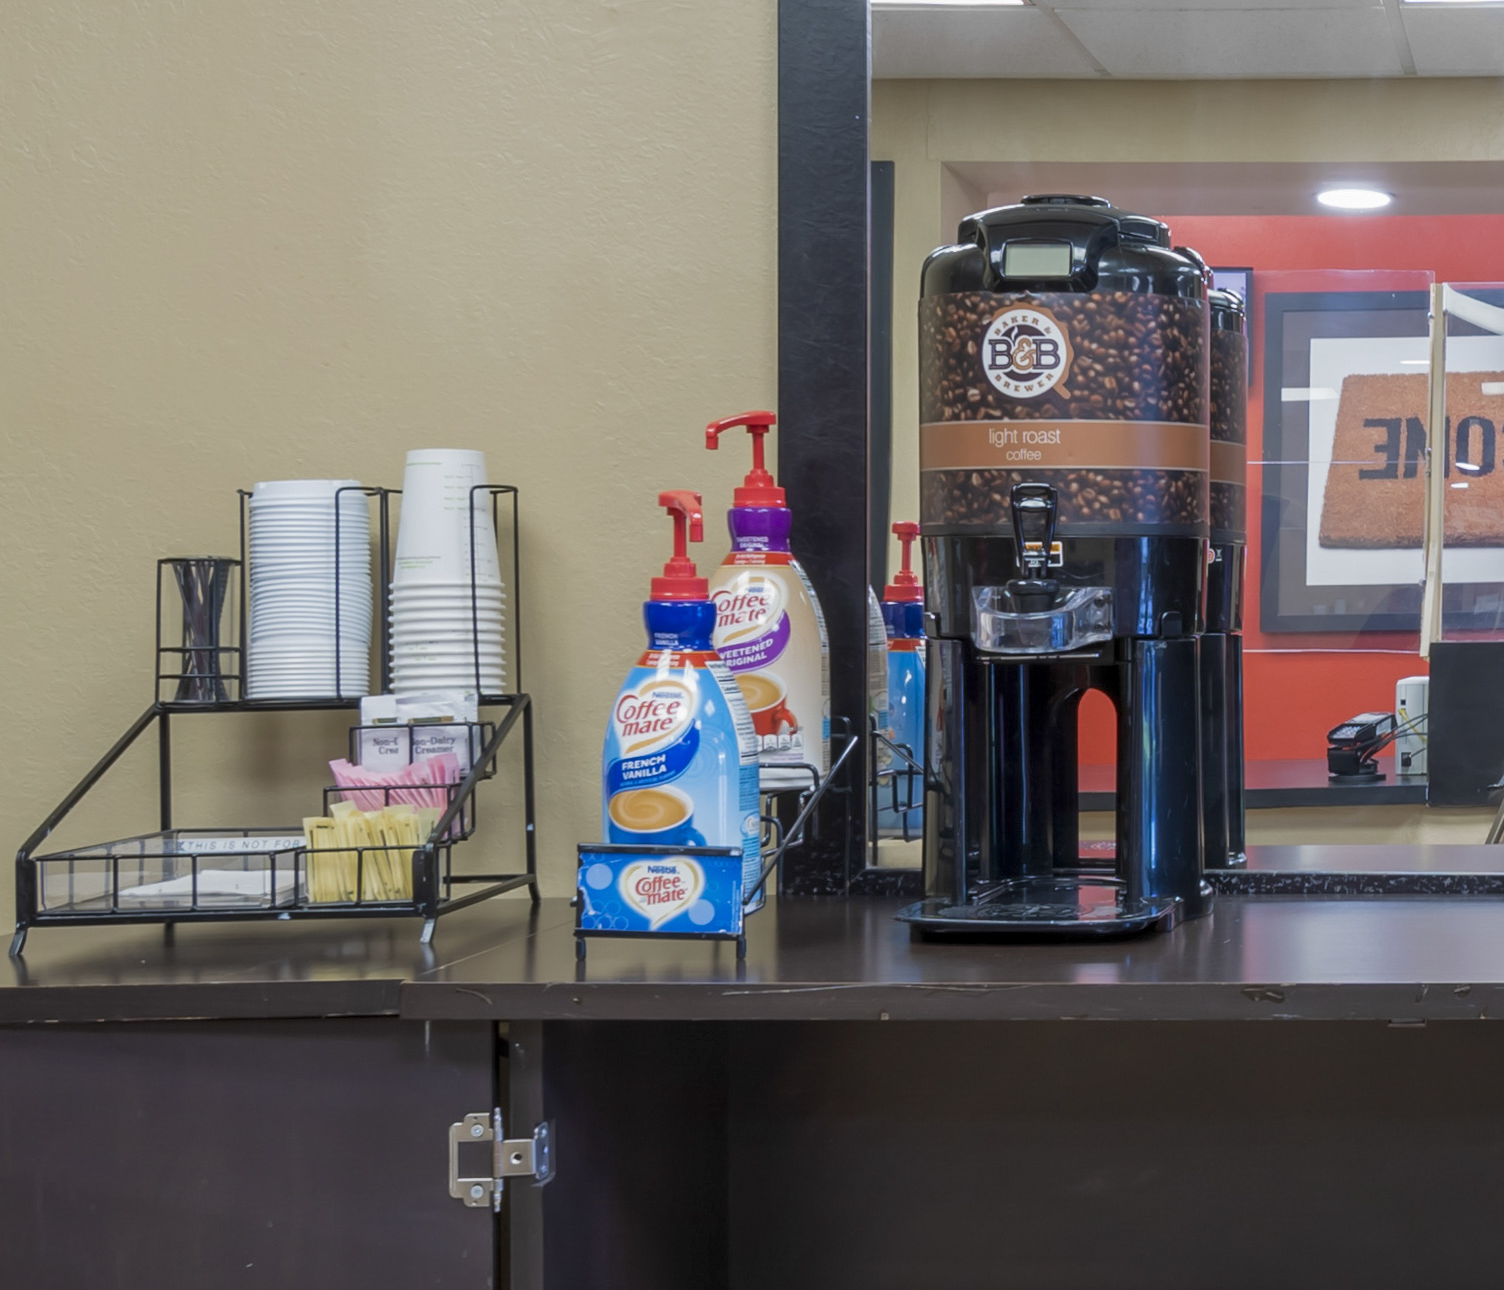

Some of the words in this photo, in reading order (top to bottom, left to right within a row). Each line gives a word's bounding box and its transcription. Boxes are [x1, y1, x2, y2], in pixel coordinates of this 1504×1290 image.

[994, 315, 1040, 336] BAKER
[988, 337, 1061, 371] B&B
[994, 372, 1054, 393] BREWER
[988, 427, 1019, 448] light
[1022, 428, 1061, 445] roast
[1005, 447, 1042, 461] coffee
[720, 637, 774, 660] WEETENED
[726, 651, 768, 668] RIGINAL
[616, 694, 681, 724] Coffee
[621, 717, 673, 737] mate
[415, 746, 454, 755] Creamer
[621, 753, 666, 771] FRENCH
[622, 764, 667, 781] VANILLA
[188, 840, 217, 851] THIS
[223, 839, 235, 850] IS
[242, 840, 267, 850] NOT
[274, 839, 301, 849] FOR
[634, 876, 681, 897] Coffee
[646, 888, 686, 906] mate
